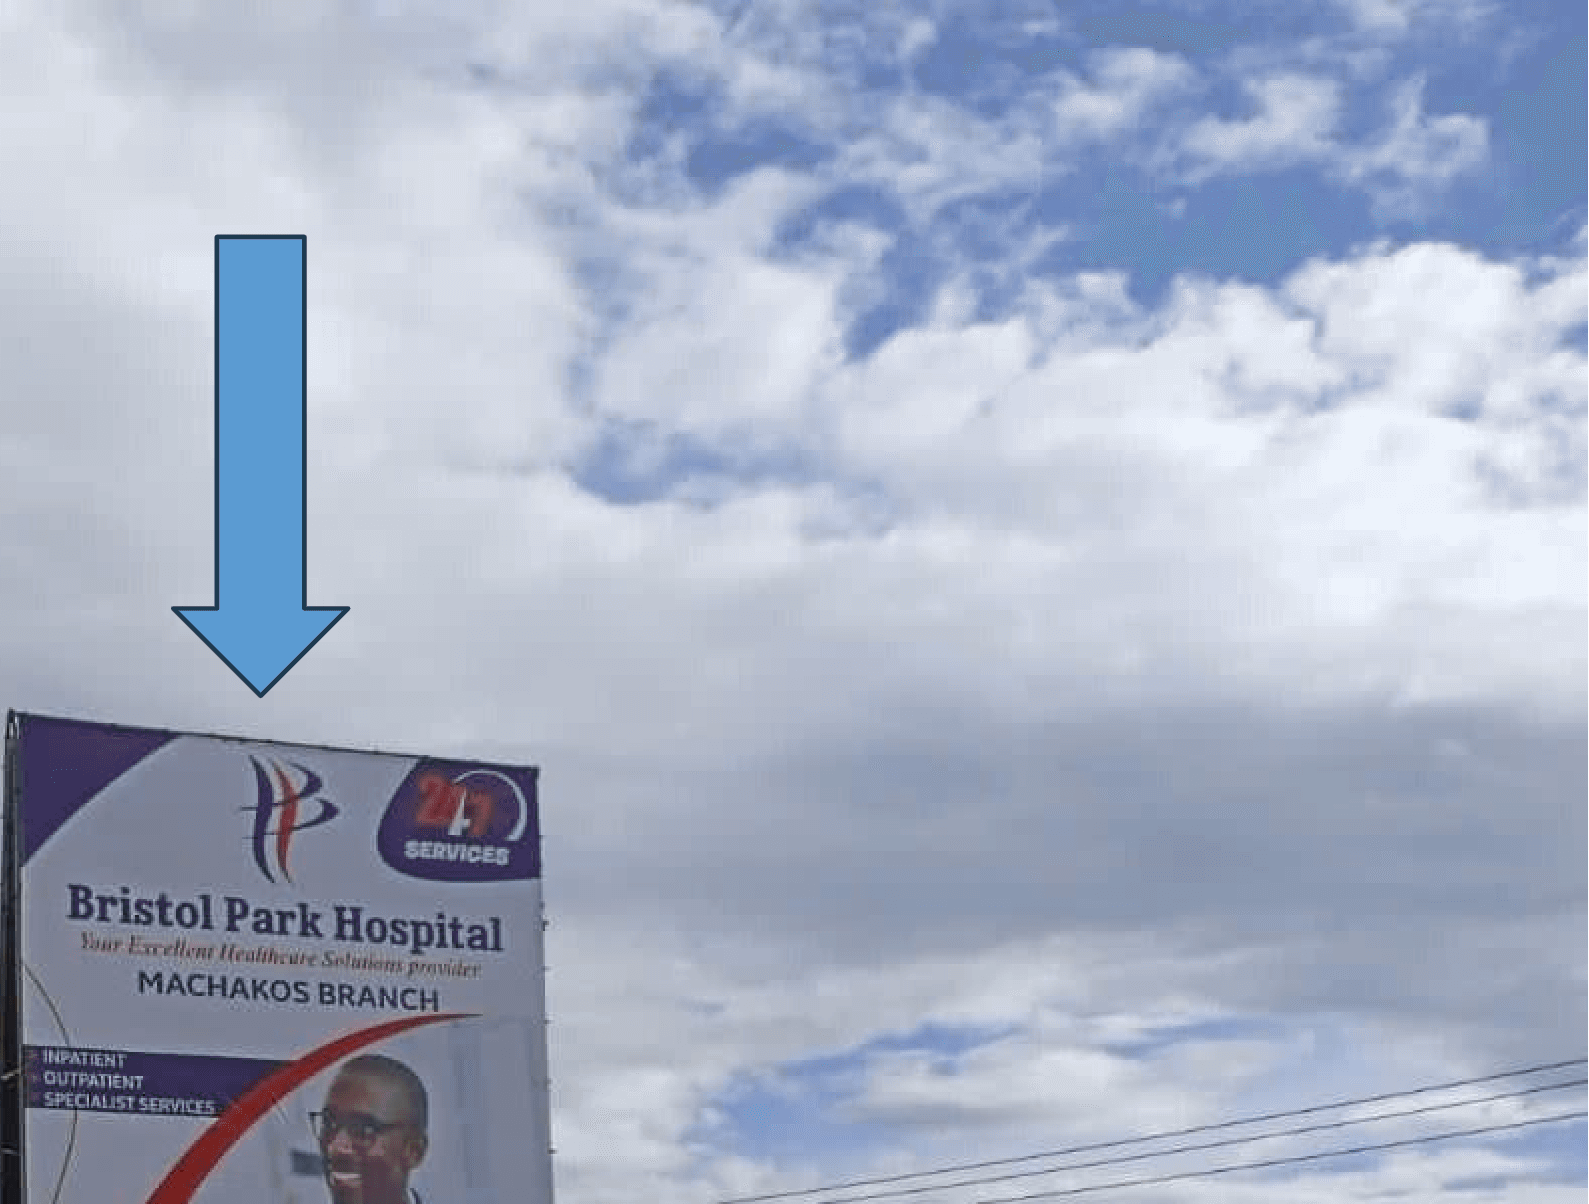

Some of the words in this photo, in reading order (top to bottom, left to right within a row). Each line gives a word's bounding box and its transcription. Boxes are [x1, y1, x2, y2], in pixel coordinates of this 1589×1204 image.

[404, 840, 510, 866] SERVICES
[67, 884, 212, 931] Bristol
[224, 897, 323, 939] Park
[335, 906, 504, 955] Hospital
[80, 931, 121, 953] Your
[127, 934, 214, 961] Excellent
[219, 941, 316, 967] Healthcare
[323, 949, 403, 975] Solutions
[407, 959, 482, 979] provider
[138, 971, 309, 1004] MACHAKOS
[318, 985, 440, 1013] BRANCH
[43, 1048, 127, 1069] INPATIENT
[43, 1068, 144, 1090] OUTPATIENT
[43, 1090, 135, 1112] SPECIALIST
[138, 1095, 216, 1116] SERVICES
